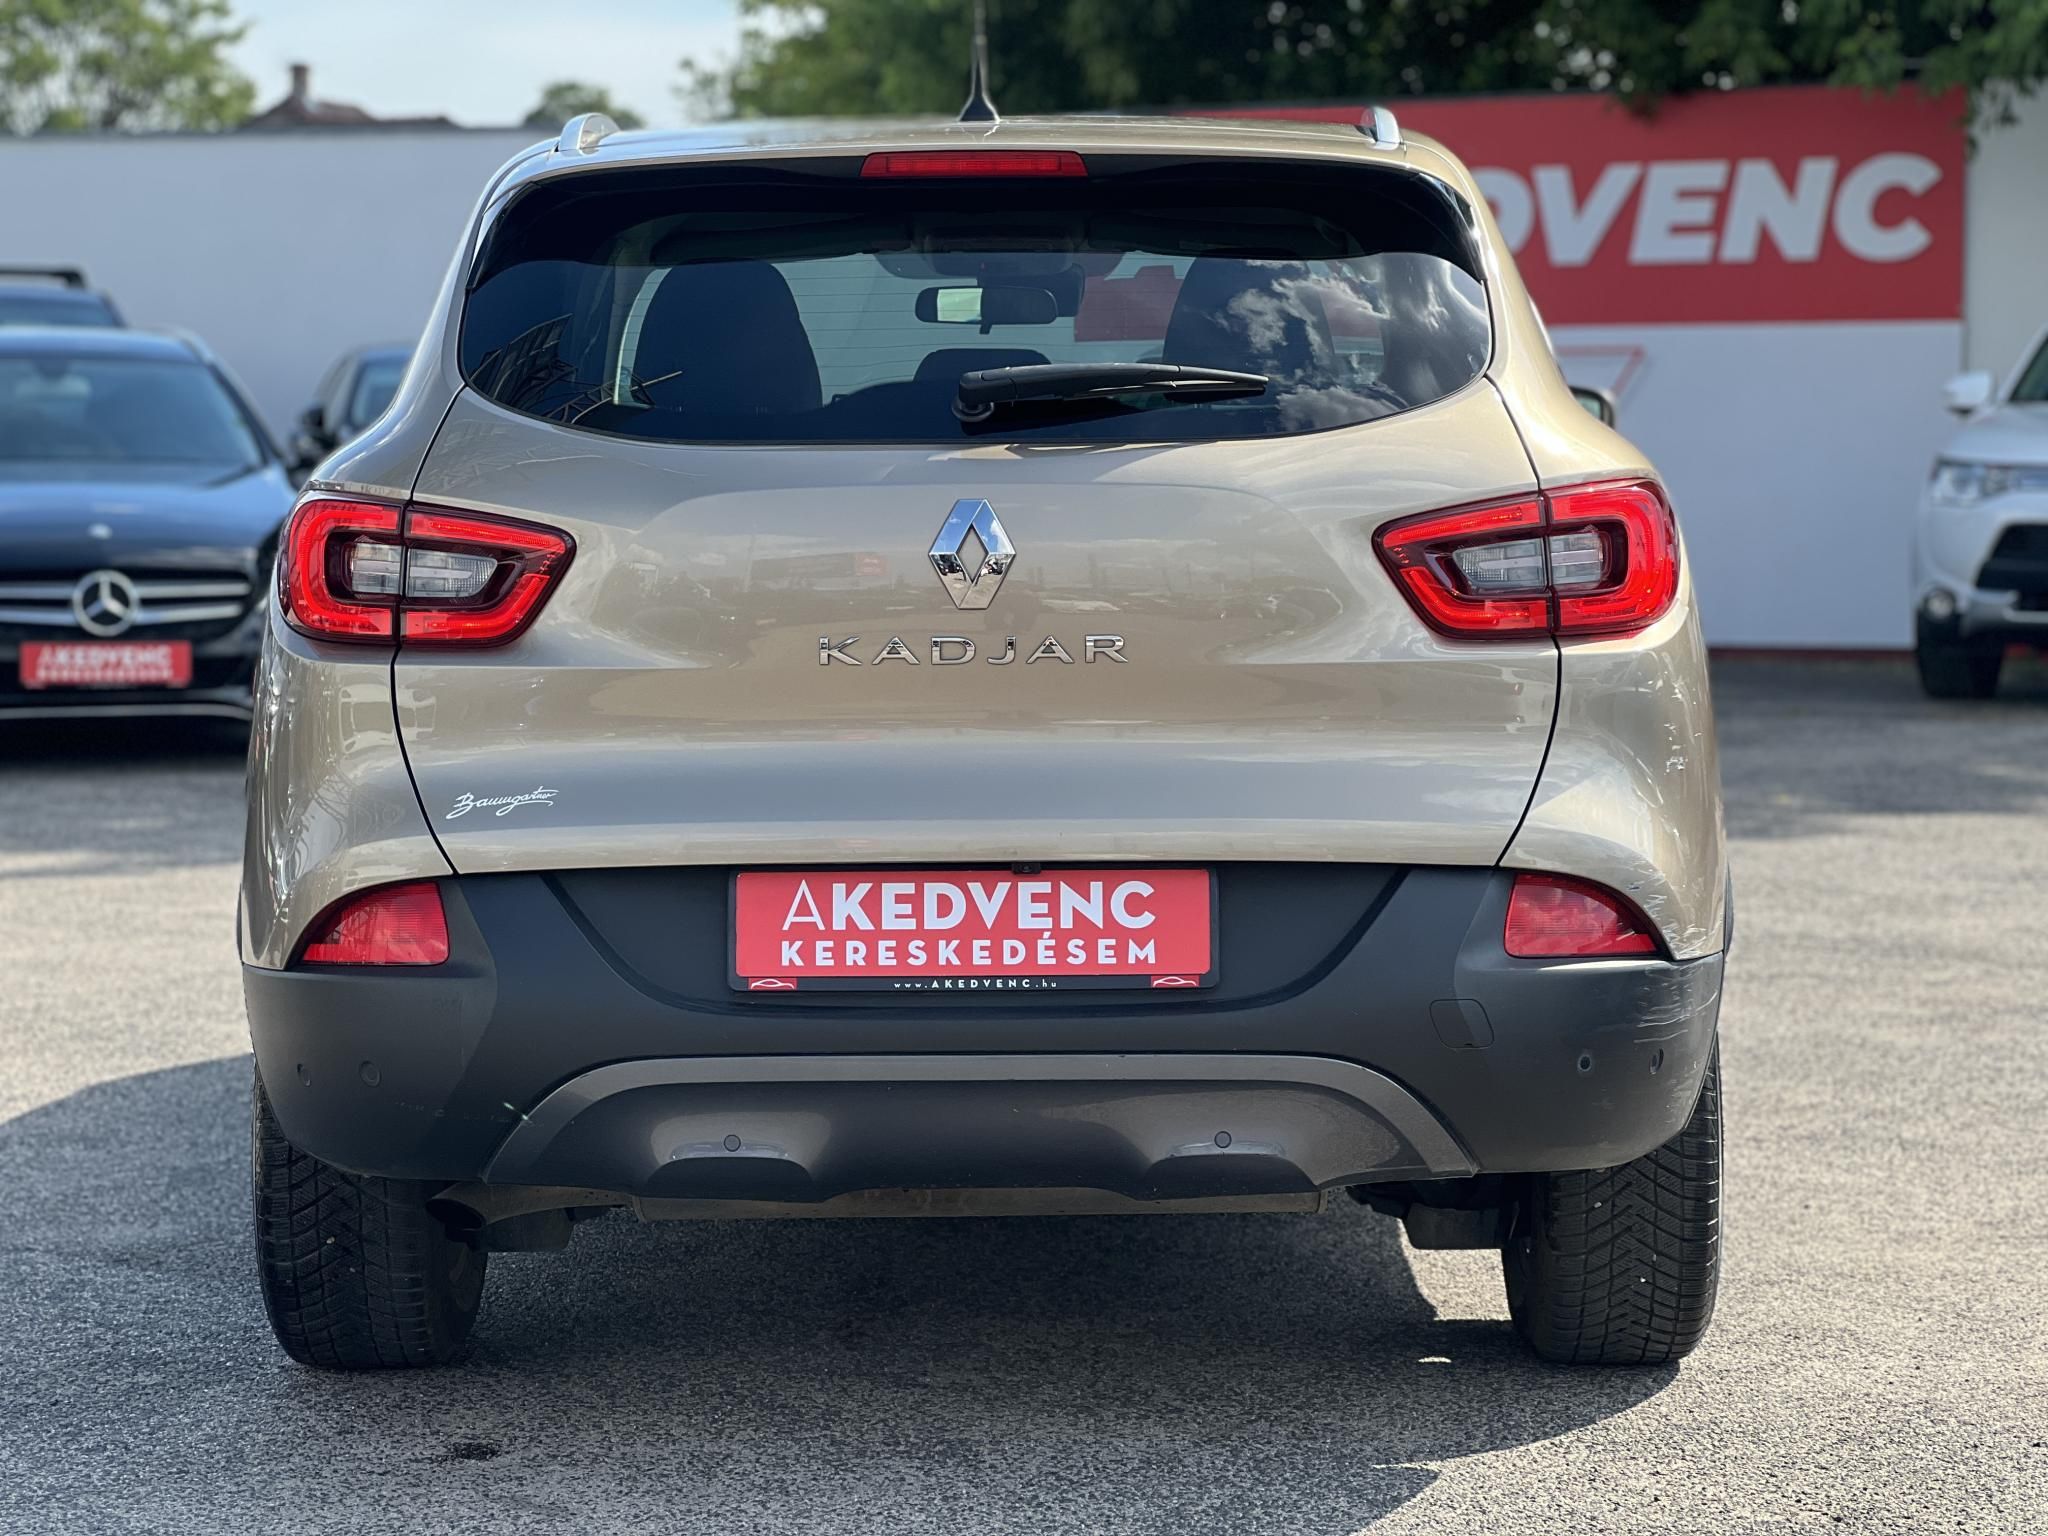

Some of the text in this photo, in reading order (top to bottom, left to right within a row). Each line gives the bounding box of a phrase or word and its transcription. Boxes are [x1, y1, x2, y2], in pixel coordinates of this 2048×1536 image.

[818, 634, 1129, 666] KADJAR
[781, 878, 1156, 931] AKEDVENC
[781, 931, 1156, 967] KERESKEDÉSEM
[893, 978, 1058, 989] www.AKEDVENC.hu
